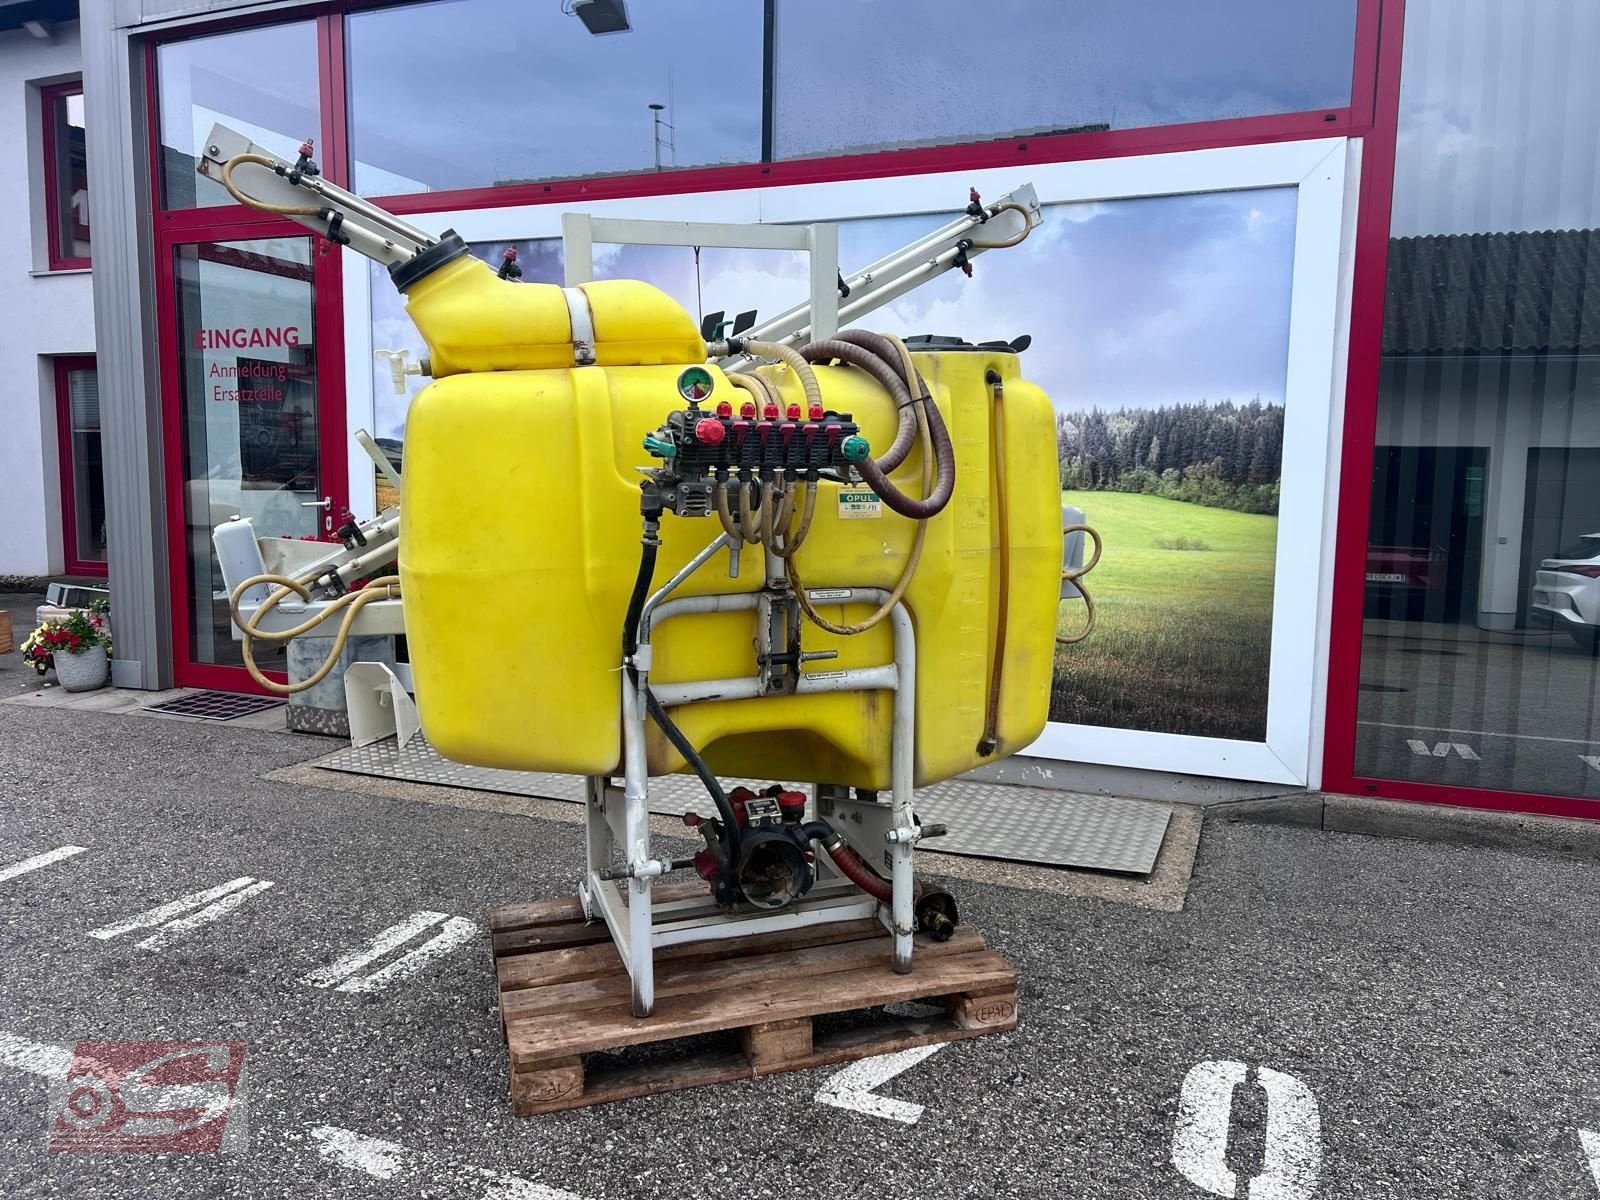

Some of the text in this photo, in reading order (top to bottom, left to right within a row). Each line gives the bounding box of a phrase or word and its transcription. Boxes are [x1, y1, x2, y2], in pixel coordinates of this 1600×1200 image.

[195, 326, 299, 350] EINGANG
[209, 361, 288, 382] Anmeldung
[213, 385, 284, 401] Ersatzteile
